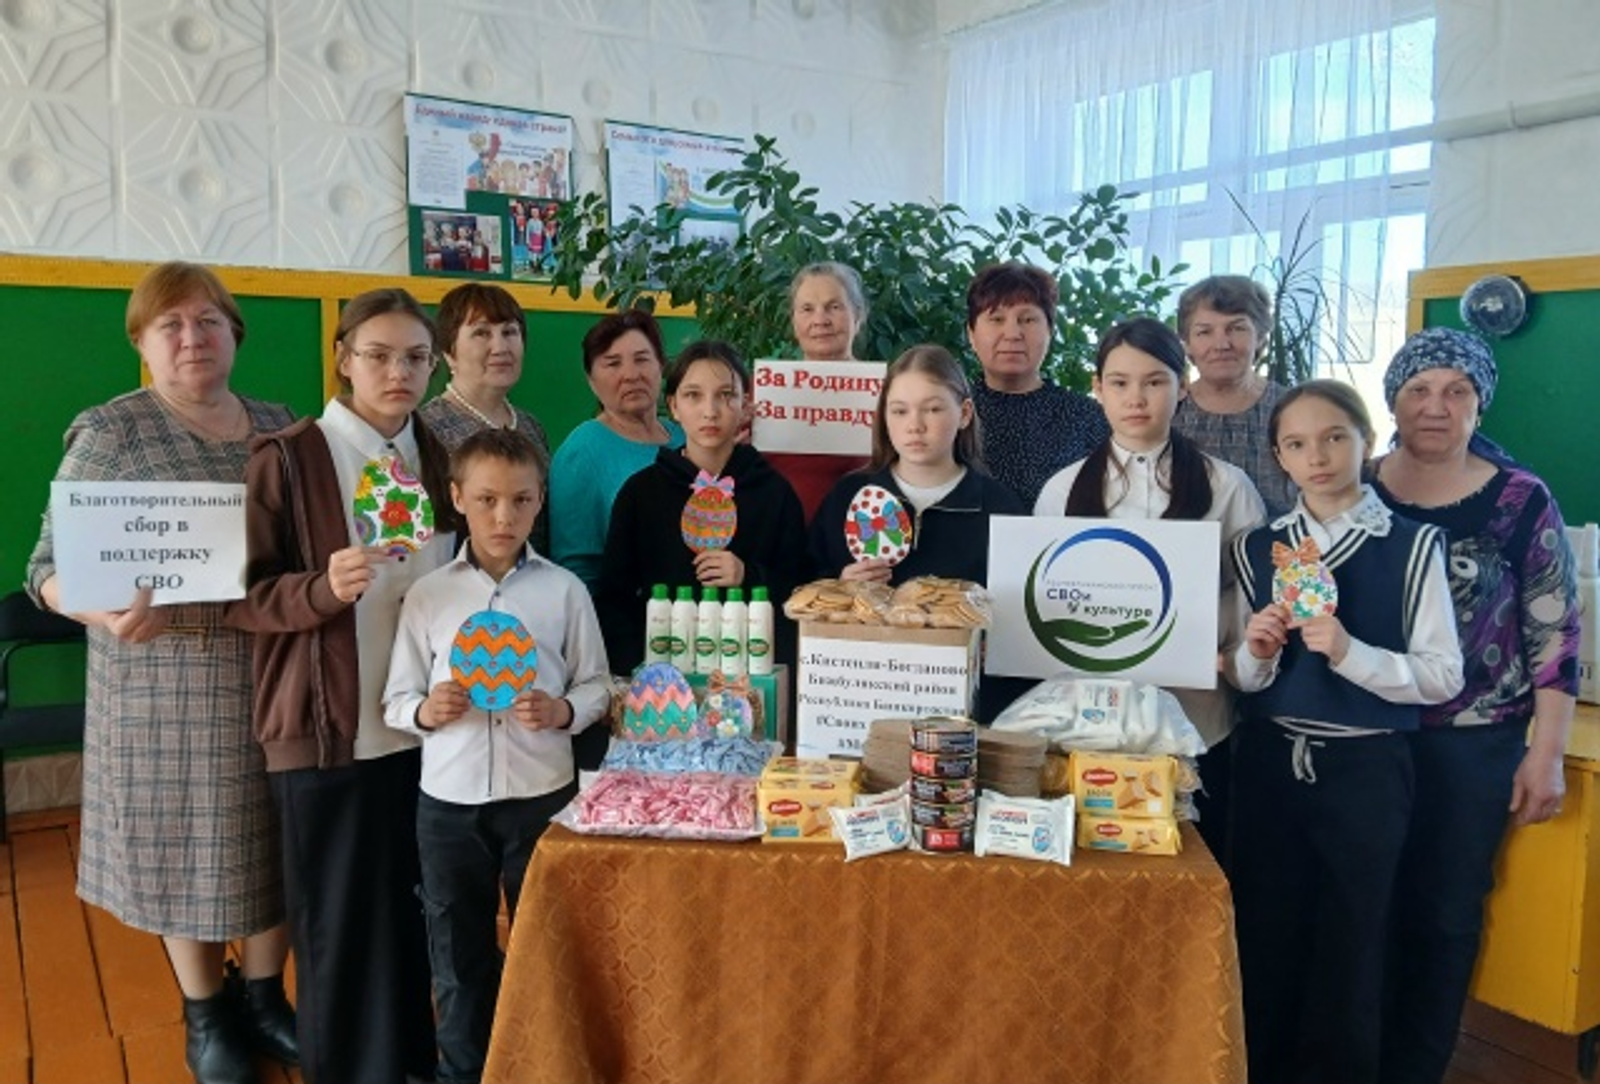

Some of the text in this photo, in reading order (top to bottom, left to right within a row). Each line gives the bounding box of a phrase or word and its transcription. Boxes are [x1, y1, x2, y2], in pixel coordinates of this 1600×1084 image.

[756, 367, 883, 396] За Родину
[756, 400, 787, 419] За
[70, 493, 242, 509] Благотворительный
[124, 516, 189, 536] сбор в
[100, 547, 213, 564] поддержку
[135, 574, 184, 590] СВО
